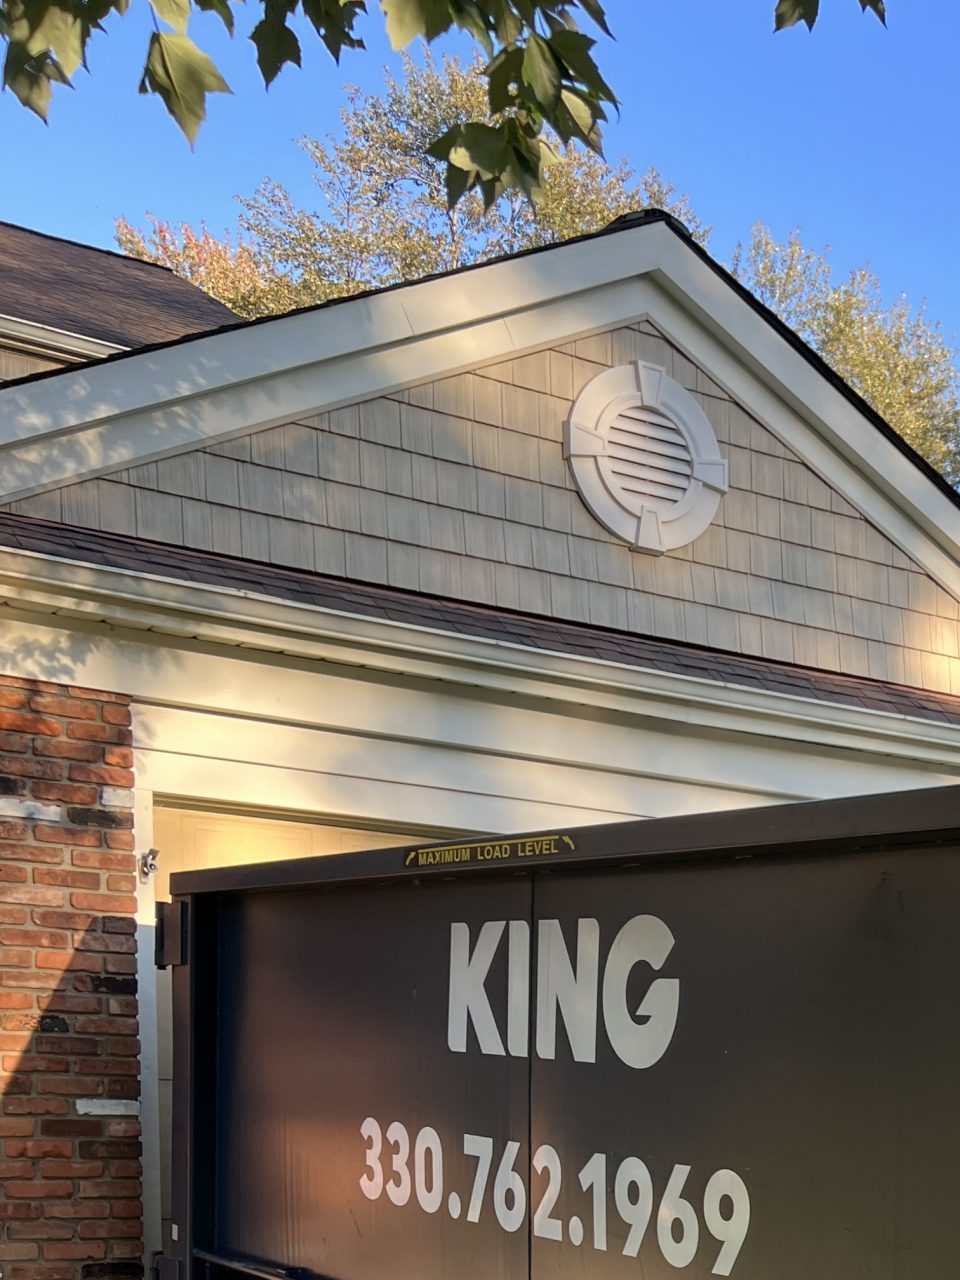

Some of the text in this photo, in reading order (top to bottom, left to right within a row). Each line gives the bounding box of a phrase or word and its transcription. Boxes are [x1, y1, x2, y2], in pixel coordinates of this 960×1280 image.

[418, 840, 559, 866] MAXIMUM LOAD LEVEL
[447, 914, 680, 1069] KING
[359, 1117, 751, 1277] 330.762.1969
